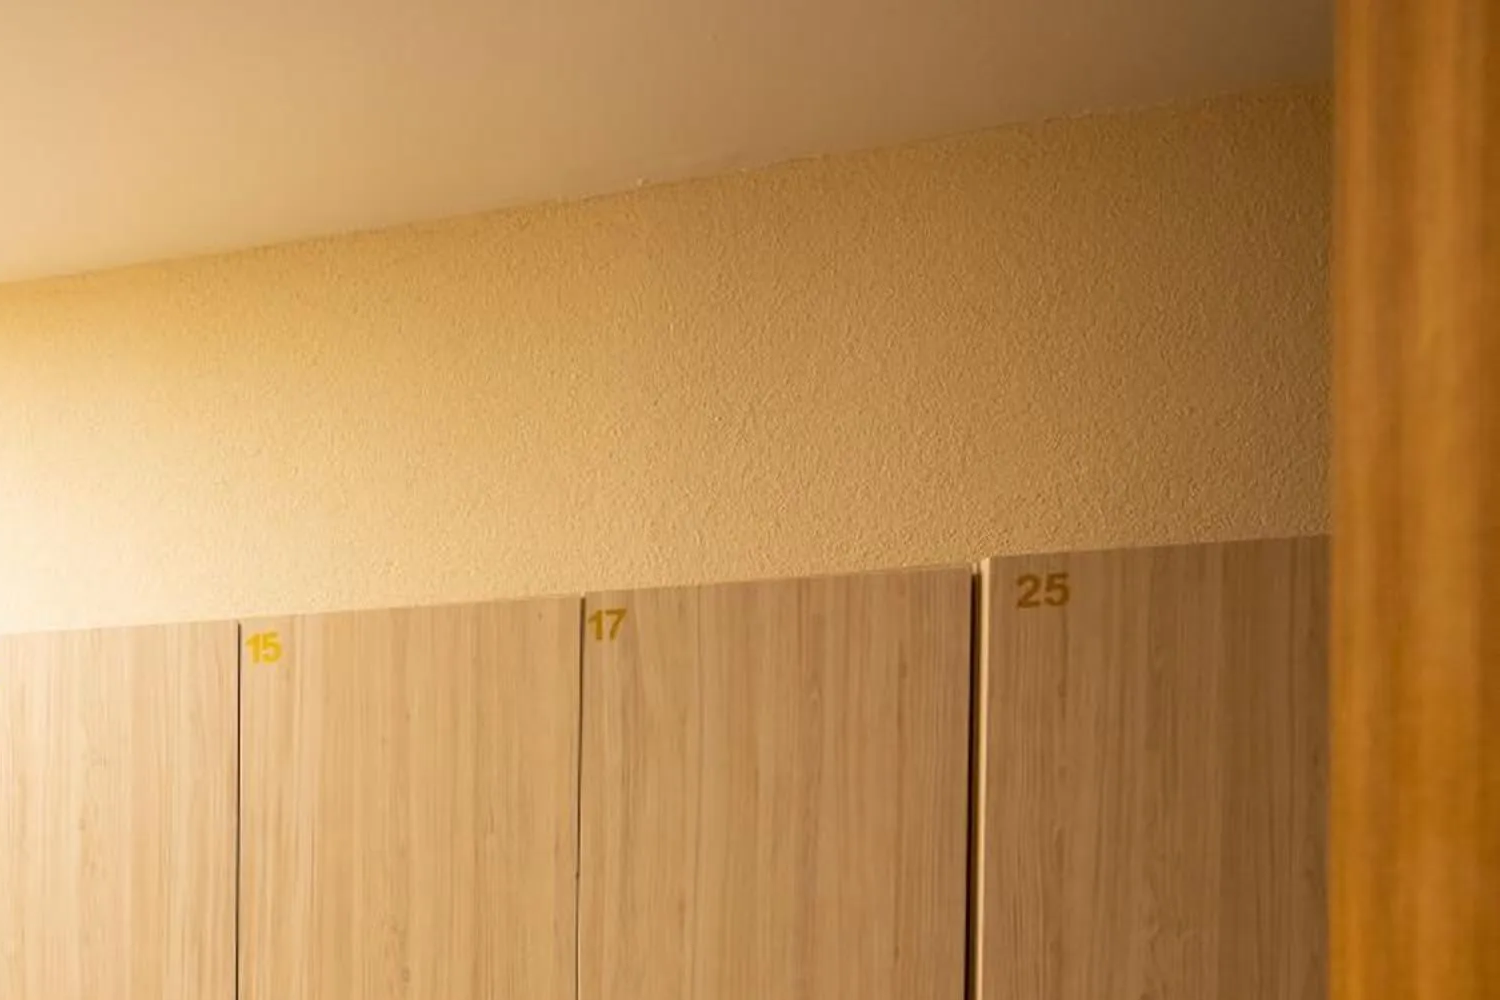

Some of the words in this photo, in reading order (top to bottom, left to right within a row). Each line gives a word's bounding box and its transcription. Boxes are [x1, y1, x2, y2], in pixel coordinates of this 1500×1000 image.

[1016, 573, 1069, 609] 25
[588, 608, 627, 641] 17
[245, 631, 281, 664] 15
